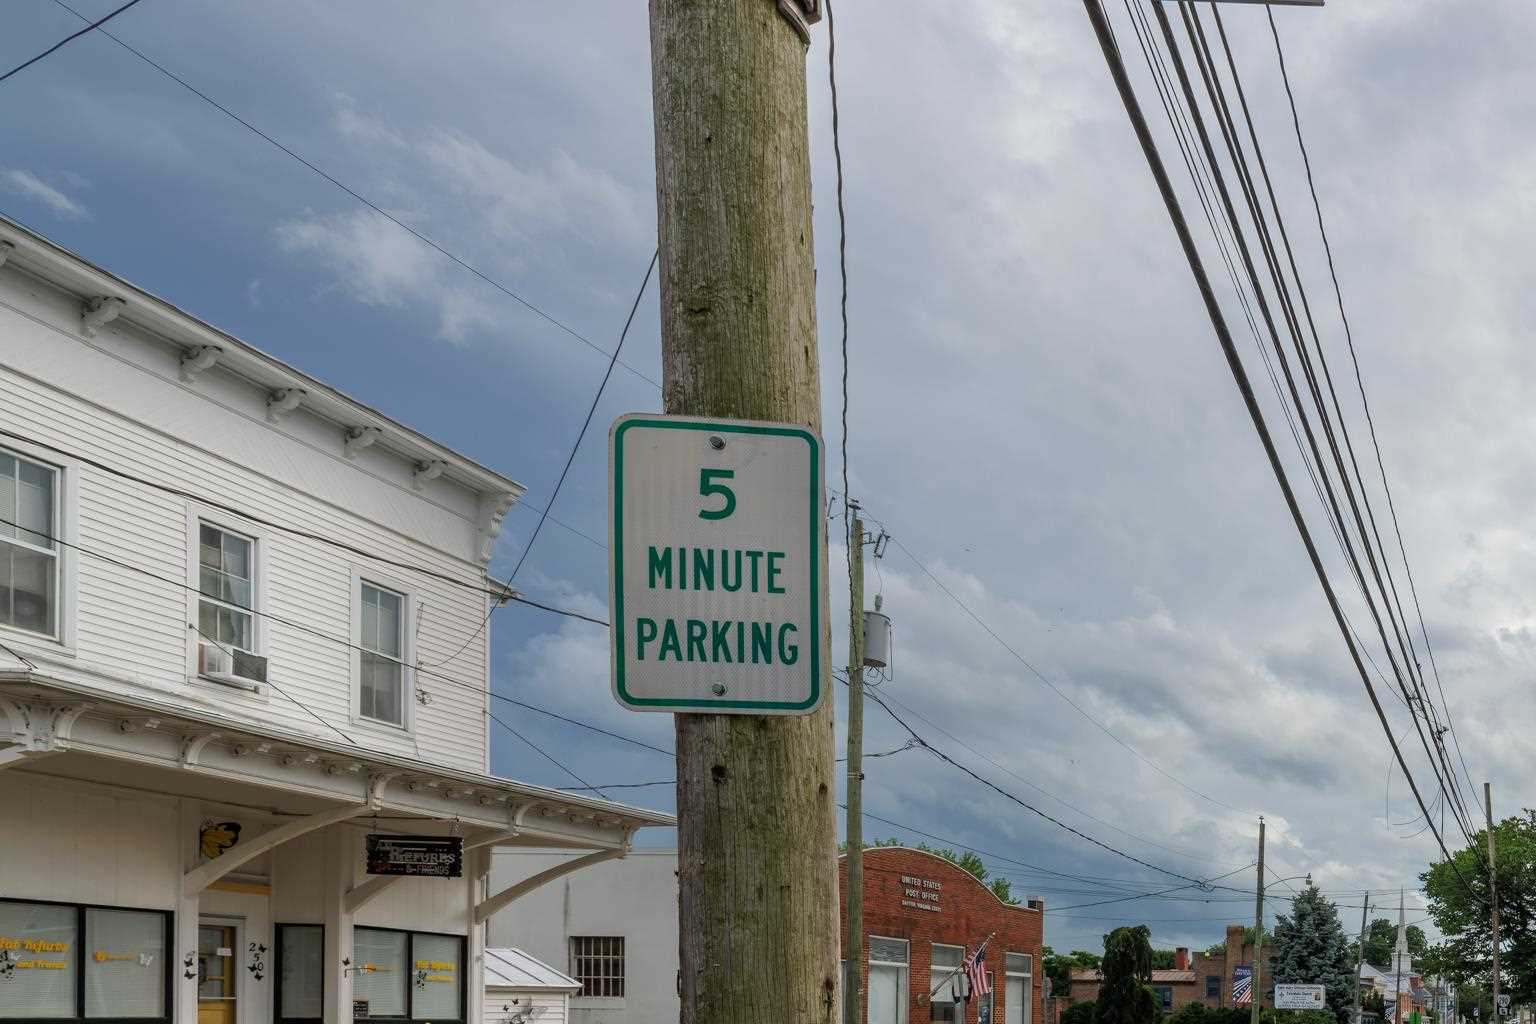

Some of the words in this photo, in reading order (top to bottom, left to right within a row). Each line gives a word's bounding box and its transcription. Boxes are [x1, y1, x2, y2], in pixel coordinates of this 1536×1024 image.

[698, 468, 737, 521] 5
[648, 545, 786, 594] MINUTE
[636, 617, 799, 666] PARKING
[901, 875, 921, 887] UNITED
[922, 879, 942, 890] STATES
[905, 888, 920, 898] POST
[921, 891, 939, 902] OFFICE
